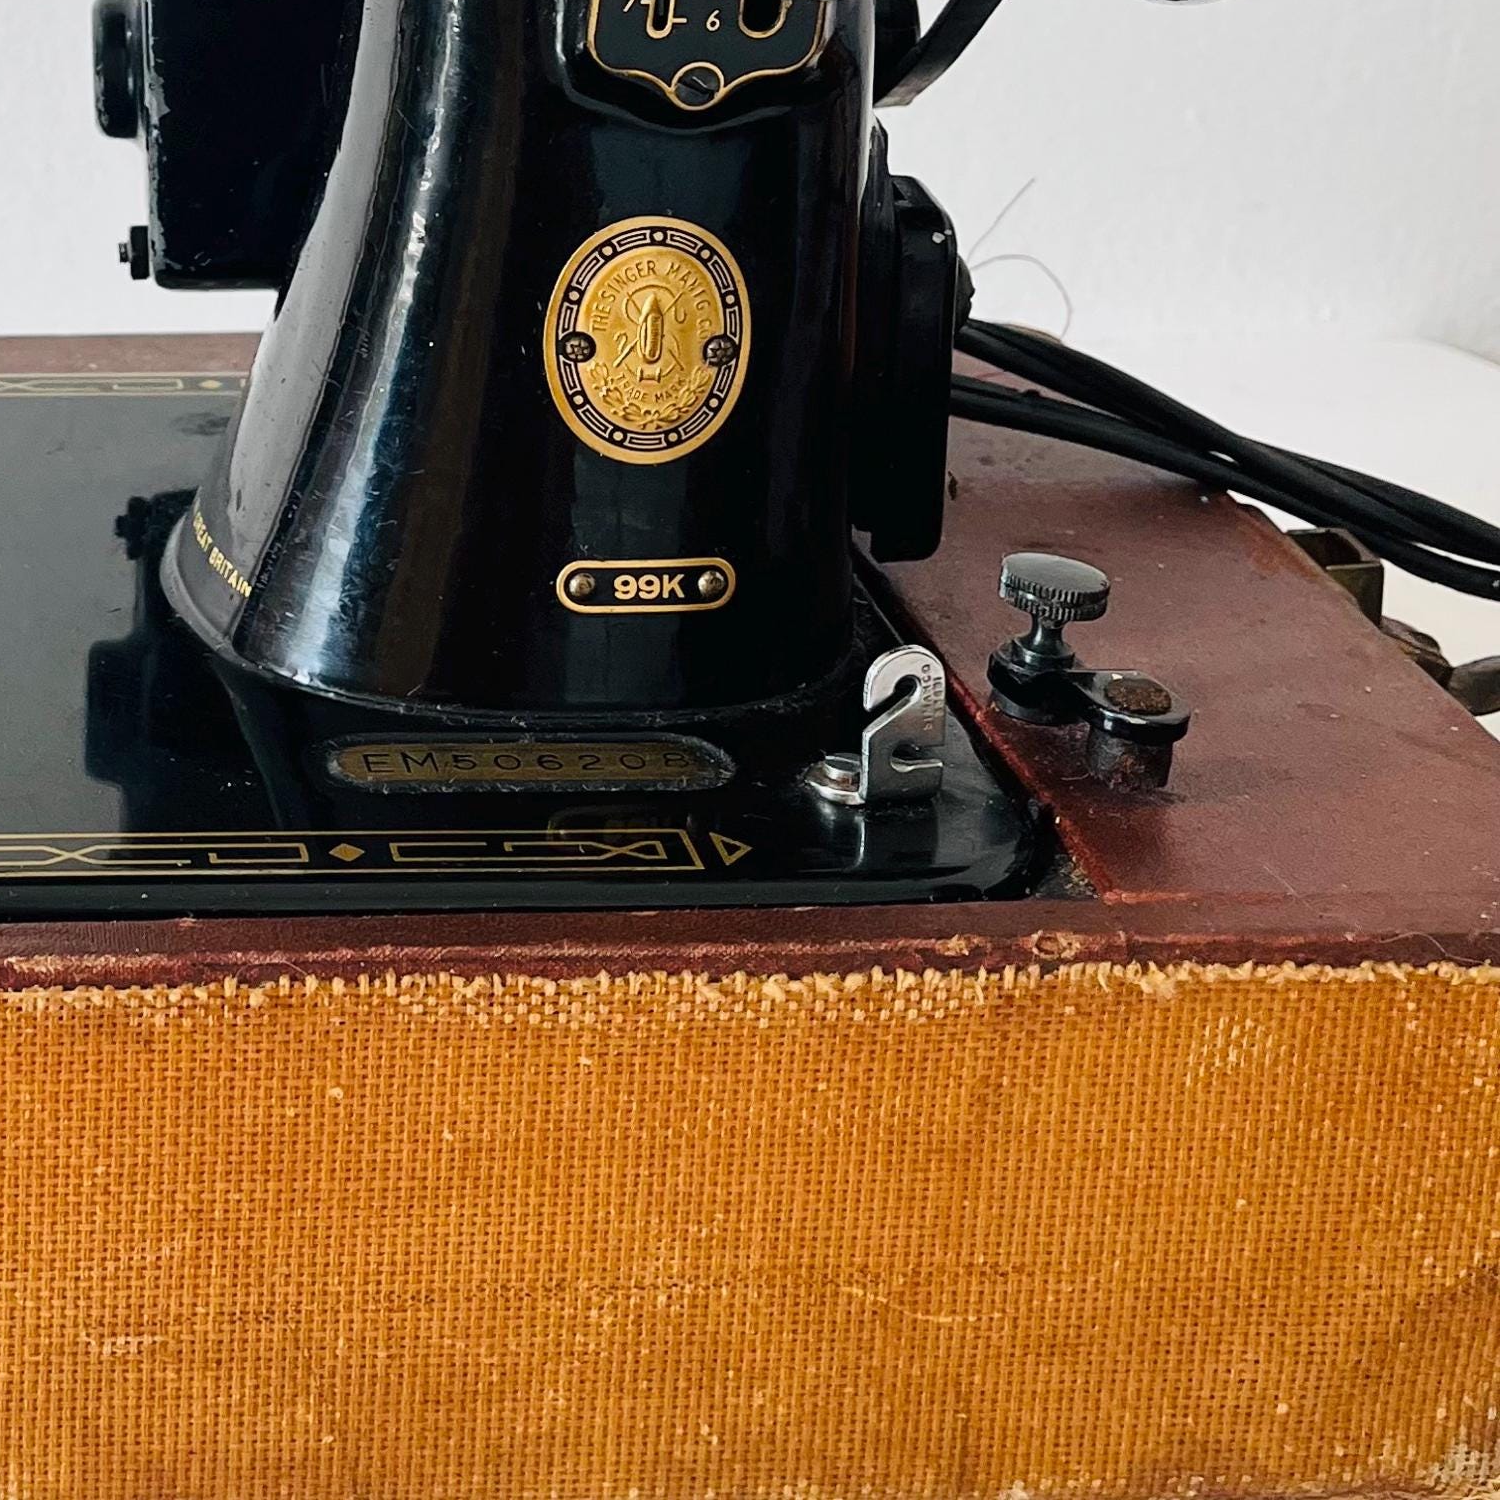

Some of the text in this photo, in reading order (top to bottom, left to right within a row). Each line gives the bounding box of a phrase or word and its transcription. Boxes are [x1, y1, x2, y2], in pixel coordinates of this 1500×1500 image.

[706, 9, 720, 31] 6
[599, 260, 657, 303] SINGER
[591, 302, 611, 332] THE
[208, 547, 252, 598] BRITAIN
[613, 573, 686, 601] 99K
